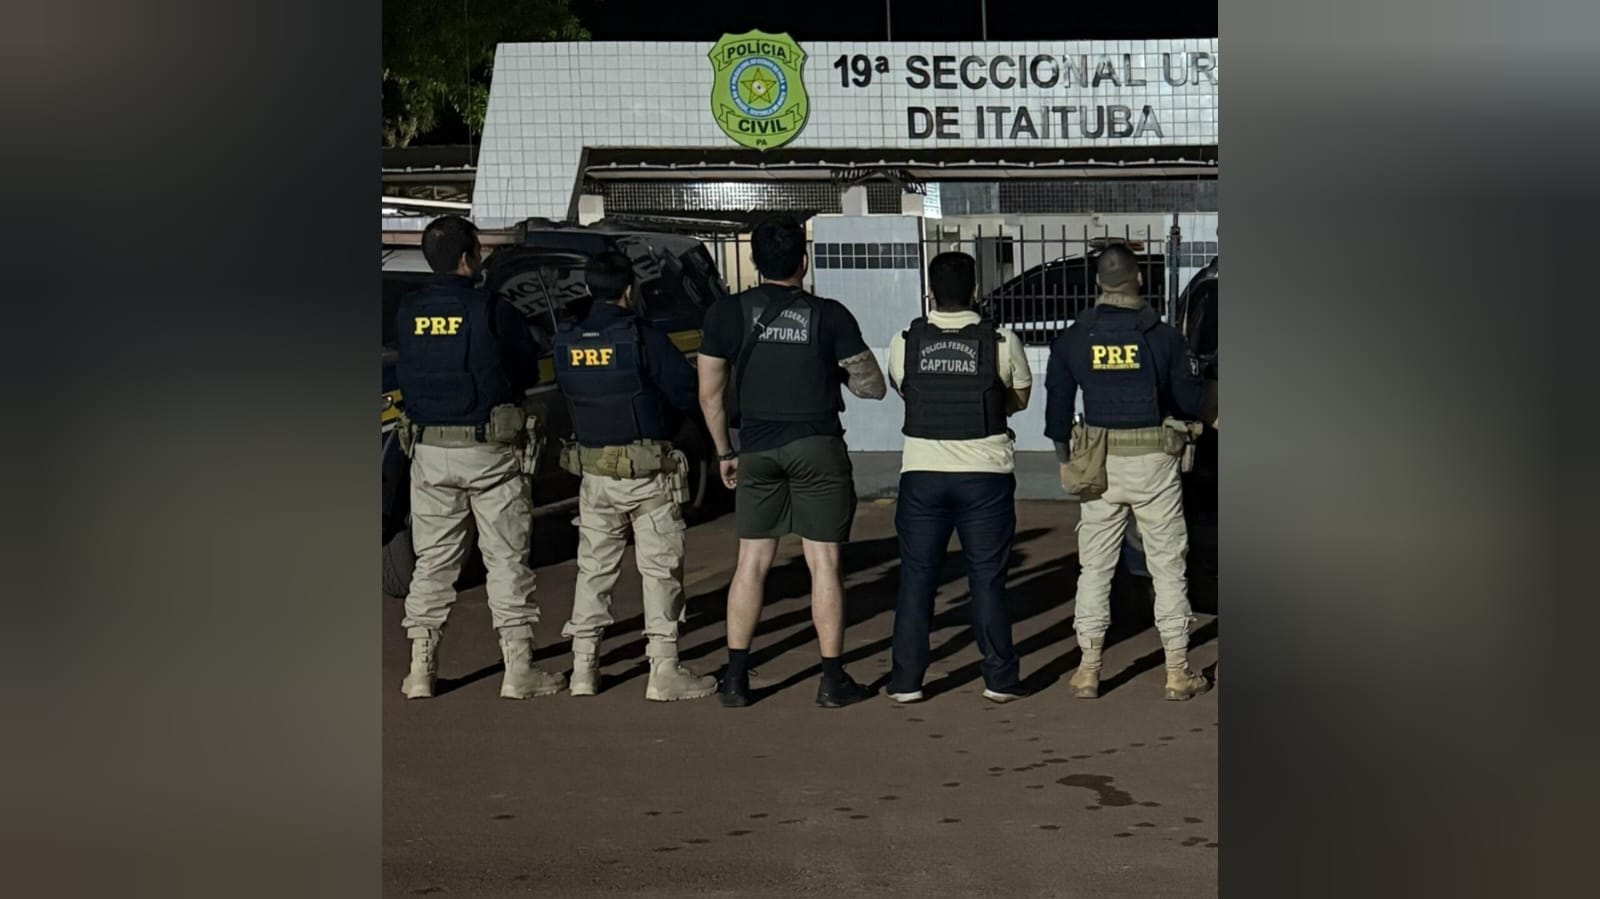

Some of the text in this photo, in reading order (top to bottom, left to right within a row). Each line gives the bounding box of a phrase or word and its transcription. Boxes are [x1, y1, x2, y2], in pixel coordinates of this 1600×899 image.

[727, 41, 786, 59] POLÍCIA
[905, 53, 1147, 90] SECCIONAL
[1162, 52, 1218, 87] UR
[738, 119, 787, 133] CIVIL
[907, 105, 1164, 139] DE ITAITUBA
[756, 138, 768, 146] PA
[414, 316, 463, 335] PRF
[758, 326, 808, 341] APTURAS
[570, 348, 613, 366] PRF
[948, 341, 976, 359] FEDERAL
[1091, 344, 1139, 364] PRF
[920, 358, 976, 373] CAPTURAS
